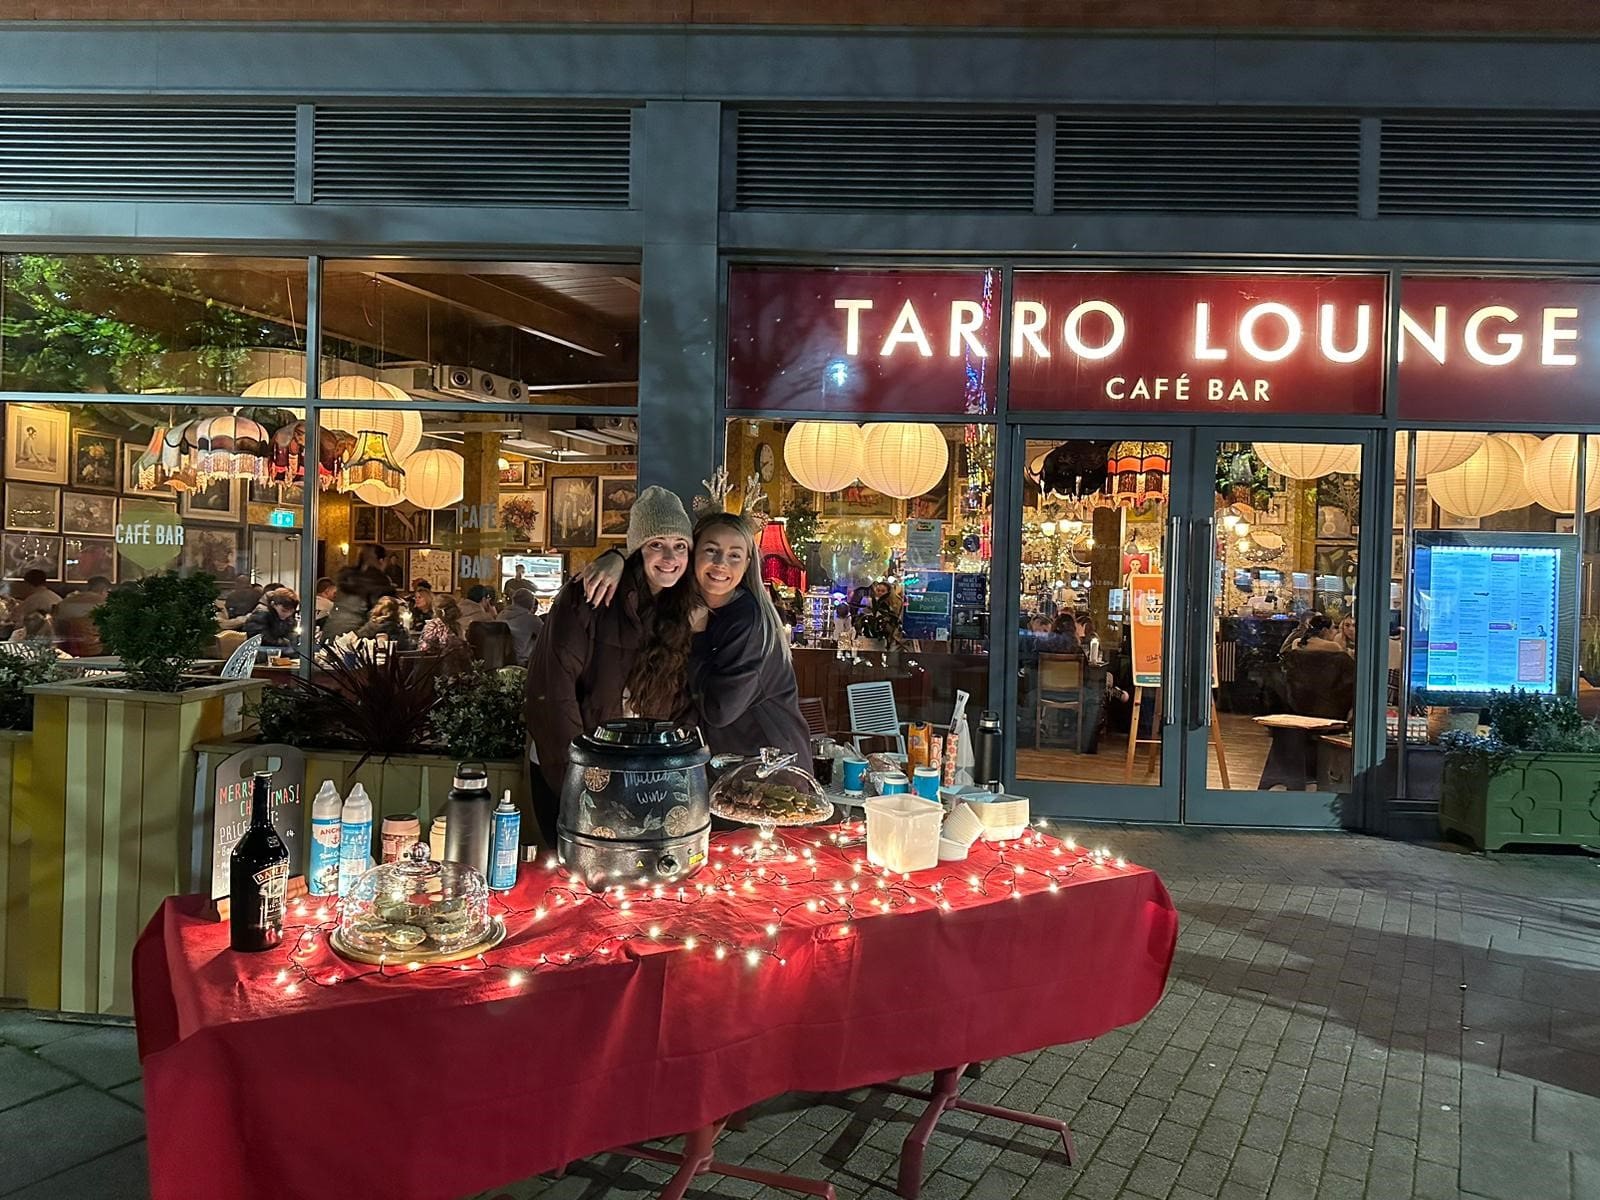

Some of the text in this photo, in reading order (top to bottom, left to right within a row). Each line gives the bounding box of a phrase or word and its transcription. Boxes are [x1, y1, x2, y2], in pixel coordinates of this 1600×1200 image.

[833, 298, 1580, 368] TARRO LOUNGE
[1105, 374, 1271, 403] CAFÉ BAR
[458, 497, 496, 529] CAFÉ
[115, 520, 184, 545] CAFÉ BAR
[461, 554, 492, 579] BAR
[624, 771, 671, 788] Mulled
[219, 780, 254, 805] MERRY
